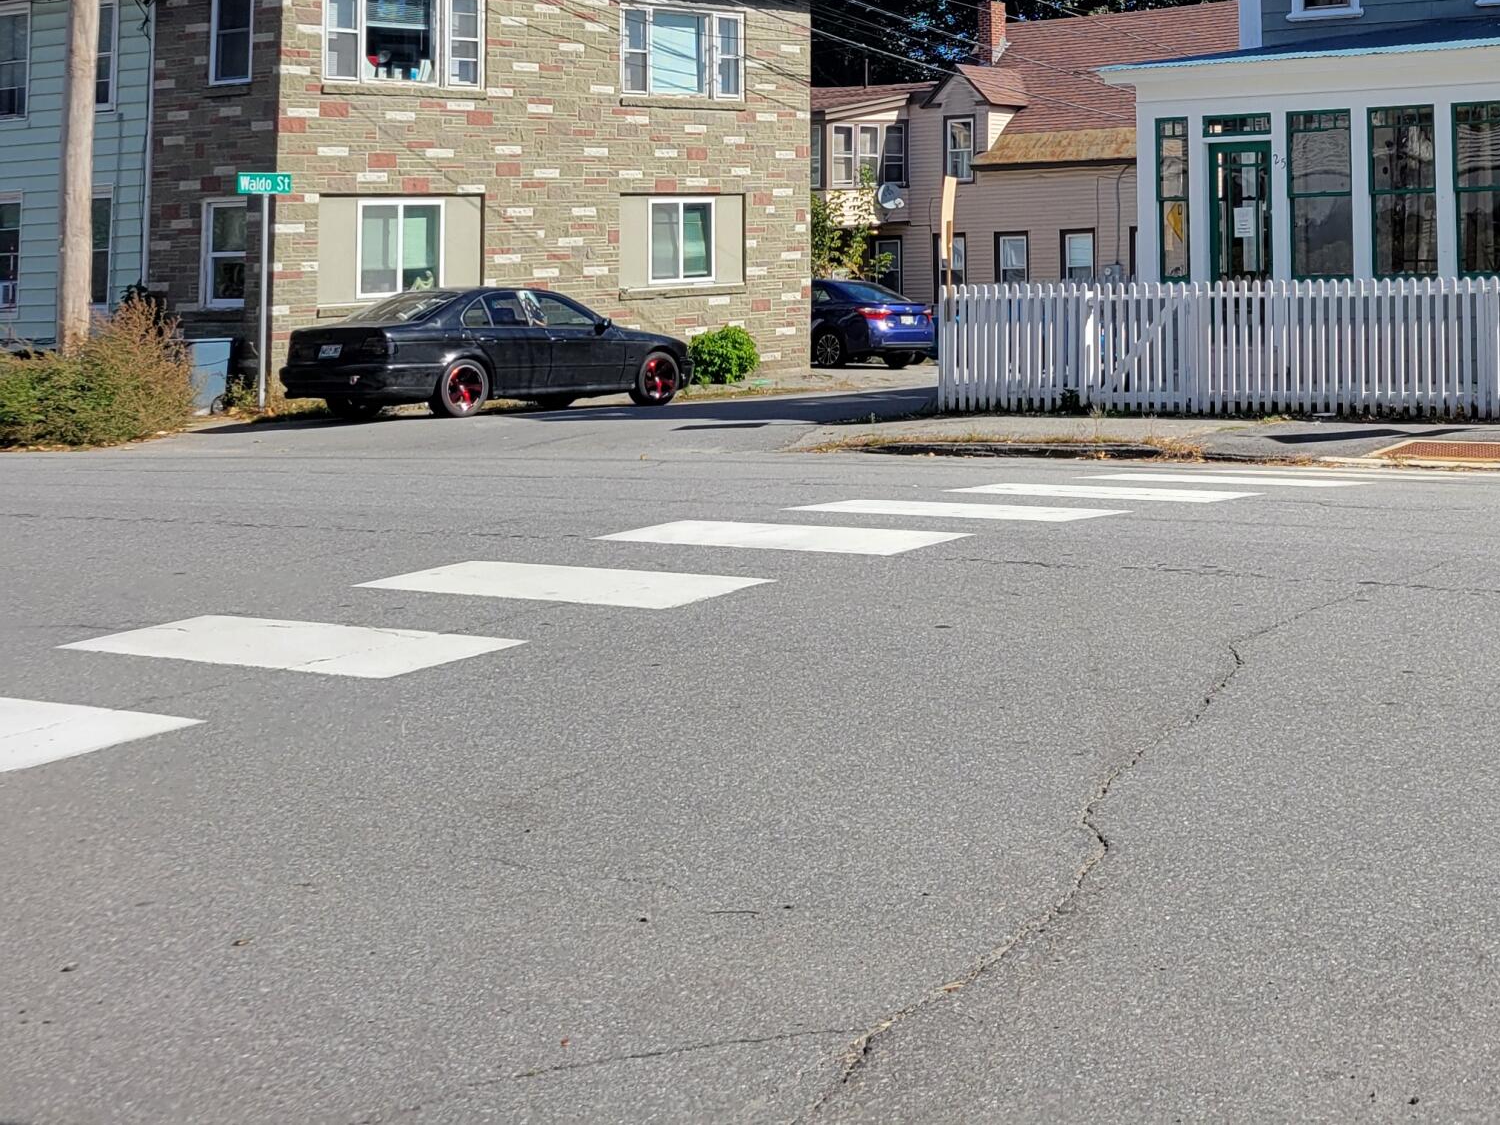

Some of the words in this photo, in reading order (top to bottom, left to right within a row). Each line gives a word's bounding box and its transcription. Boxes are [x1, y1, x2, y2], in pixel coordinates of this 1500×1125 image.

[1273, 154, 1286, 169] 25
[240, 176, 272, 191] Waldo
[277, 176, 290, 191] St
